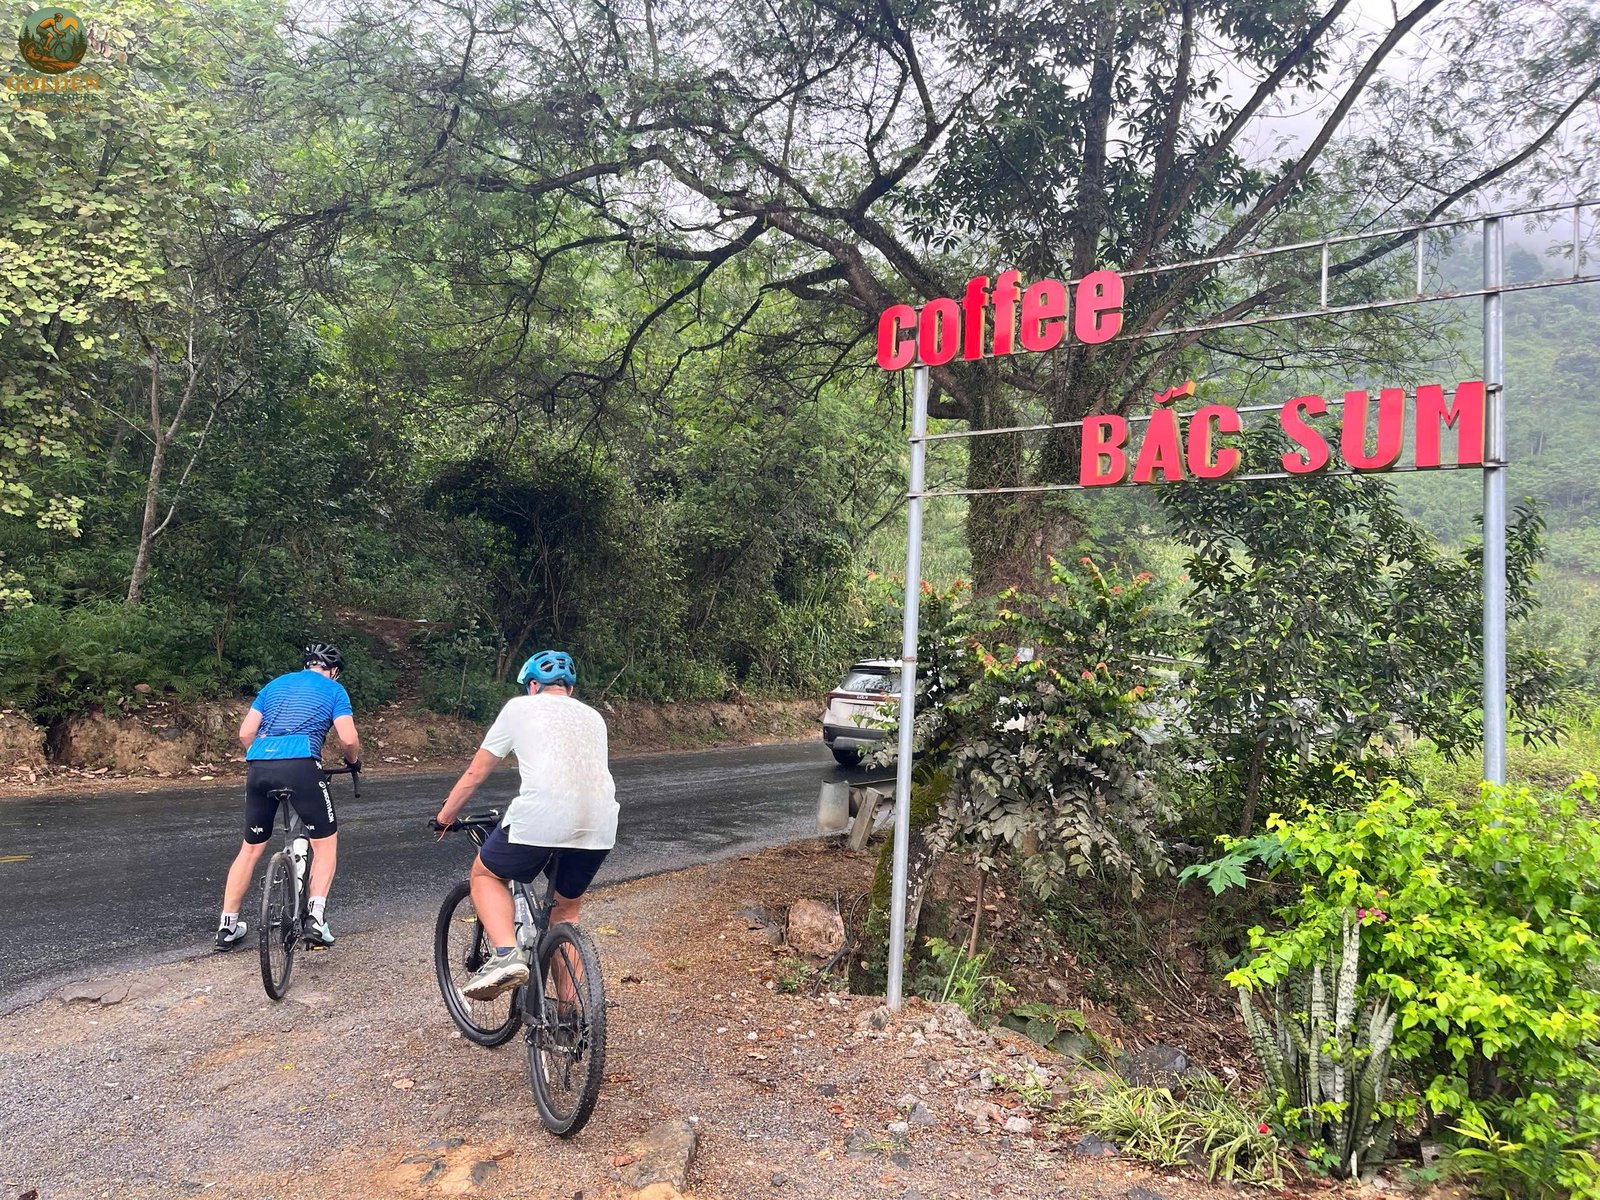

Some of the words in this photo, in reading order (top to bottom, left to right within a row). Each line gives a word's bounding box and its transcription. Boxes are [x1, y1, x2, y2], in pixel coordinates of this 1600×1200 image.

[877, 270, 1125, 372] coffee
[1080, 381, 1242, 487] BẮC
[1280, 381, 1485, 475] SUM
[322, 788, 335, 823] DECATHLON
